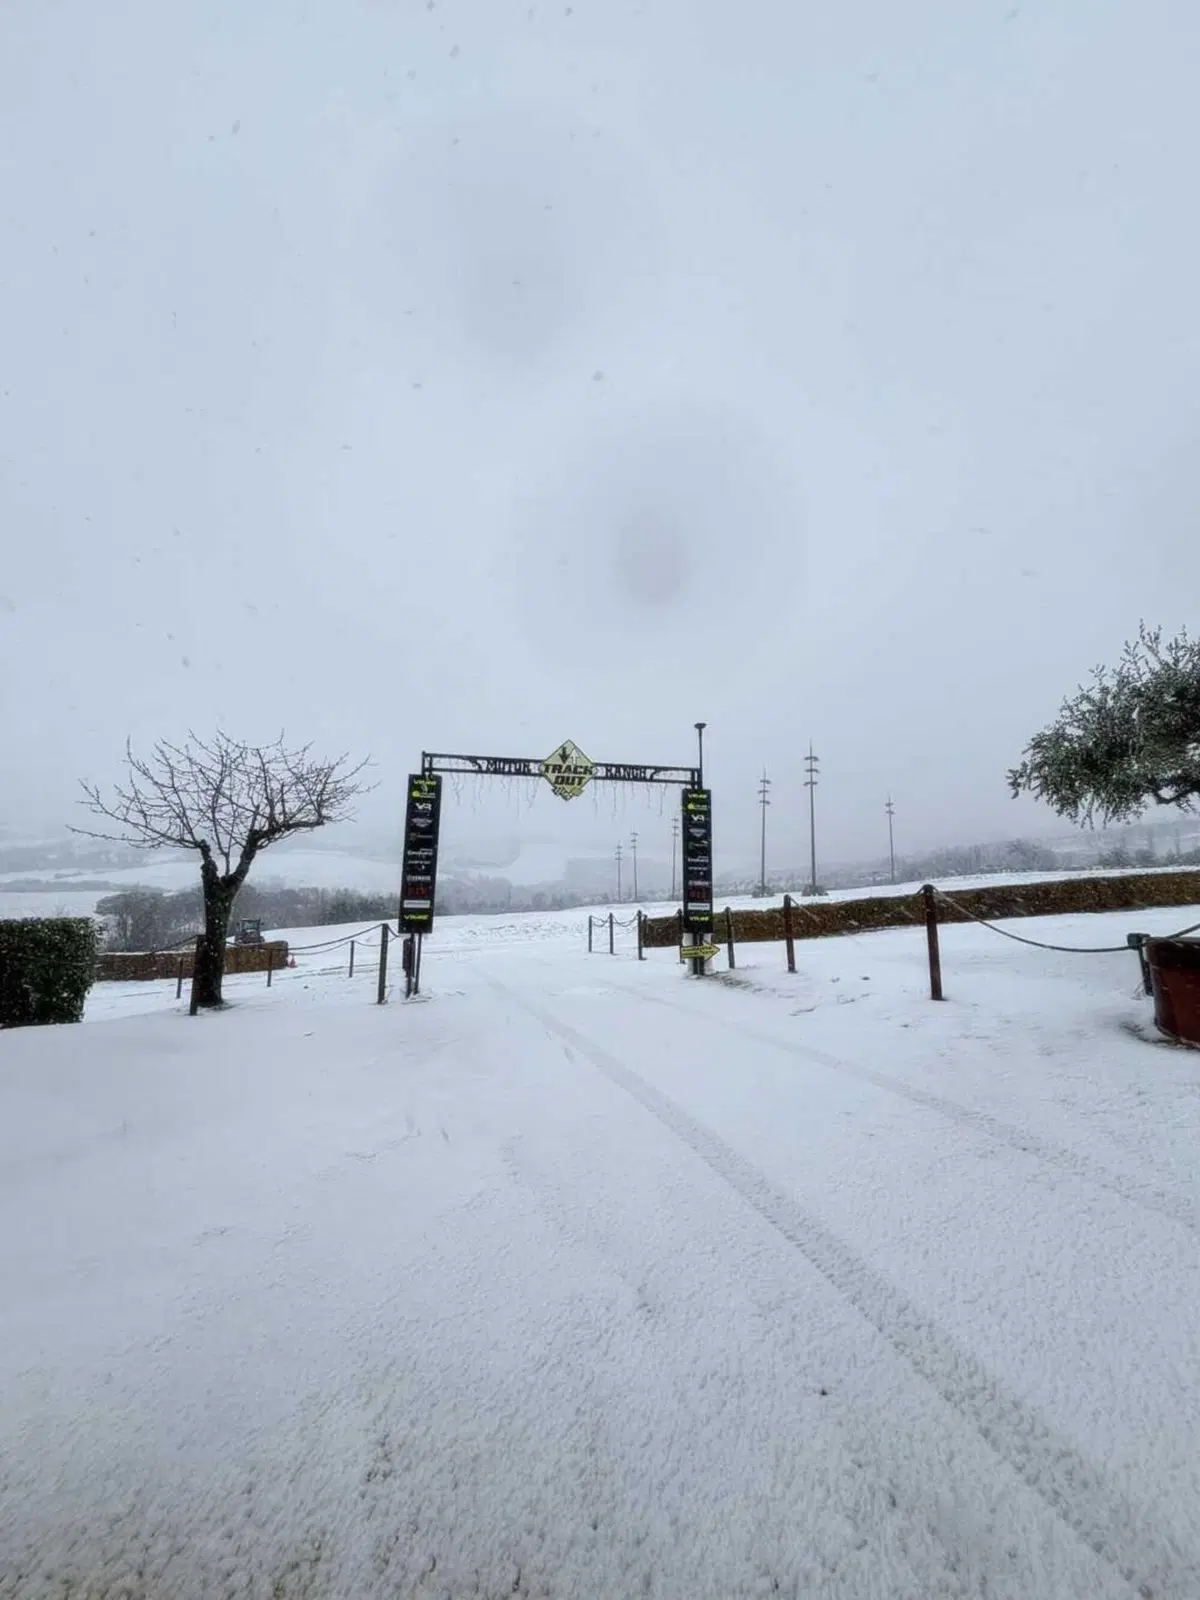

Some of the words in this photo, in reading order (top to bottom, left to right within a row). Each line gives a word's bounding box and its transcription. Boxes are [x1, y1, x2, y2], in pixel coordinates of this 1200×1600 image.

[486, 759, 533, 775] MOTOR
[605, 764, 648, 780] RANCH
[543, 763, 593, 775] TRACK
[554, 775, 586, 786] OUT
